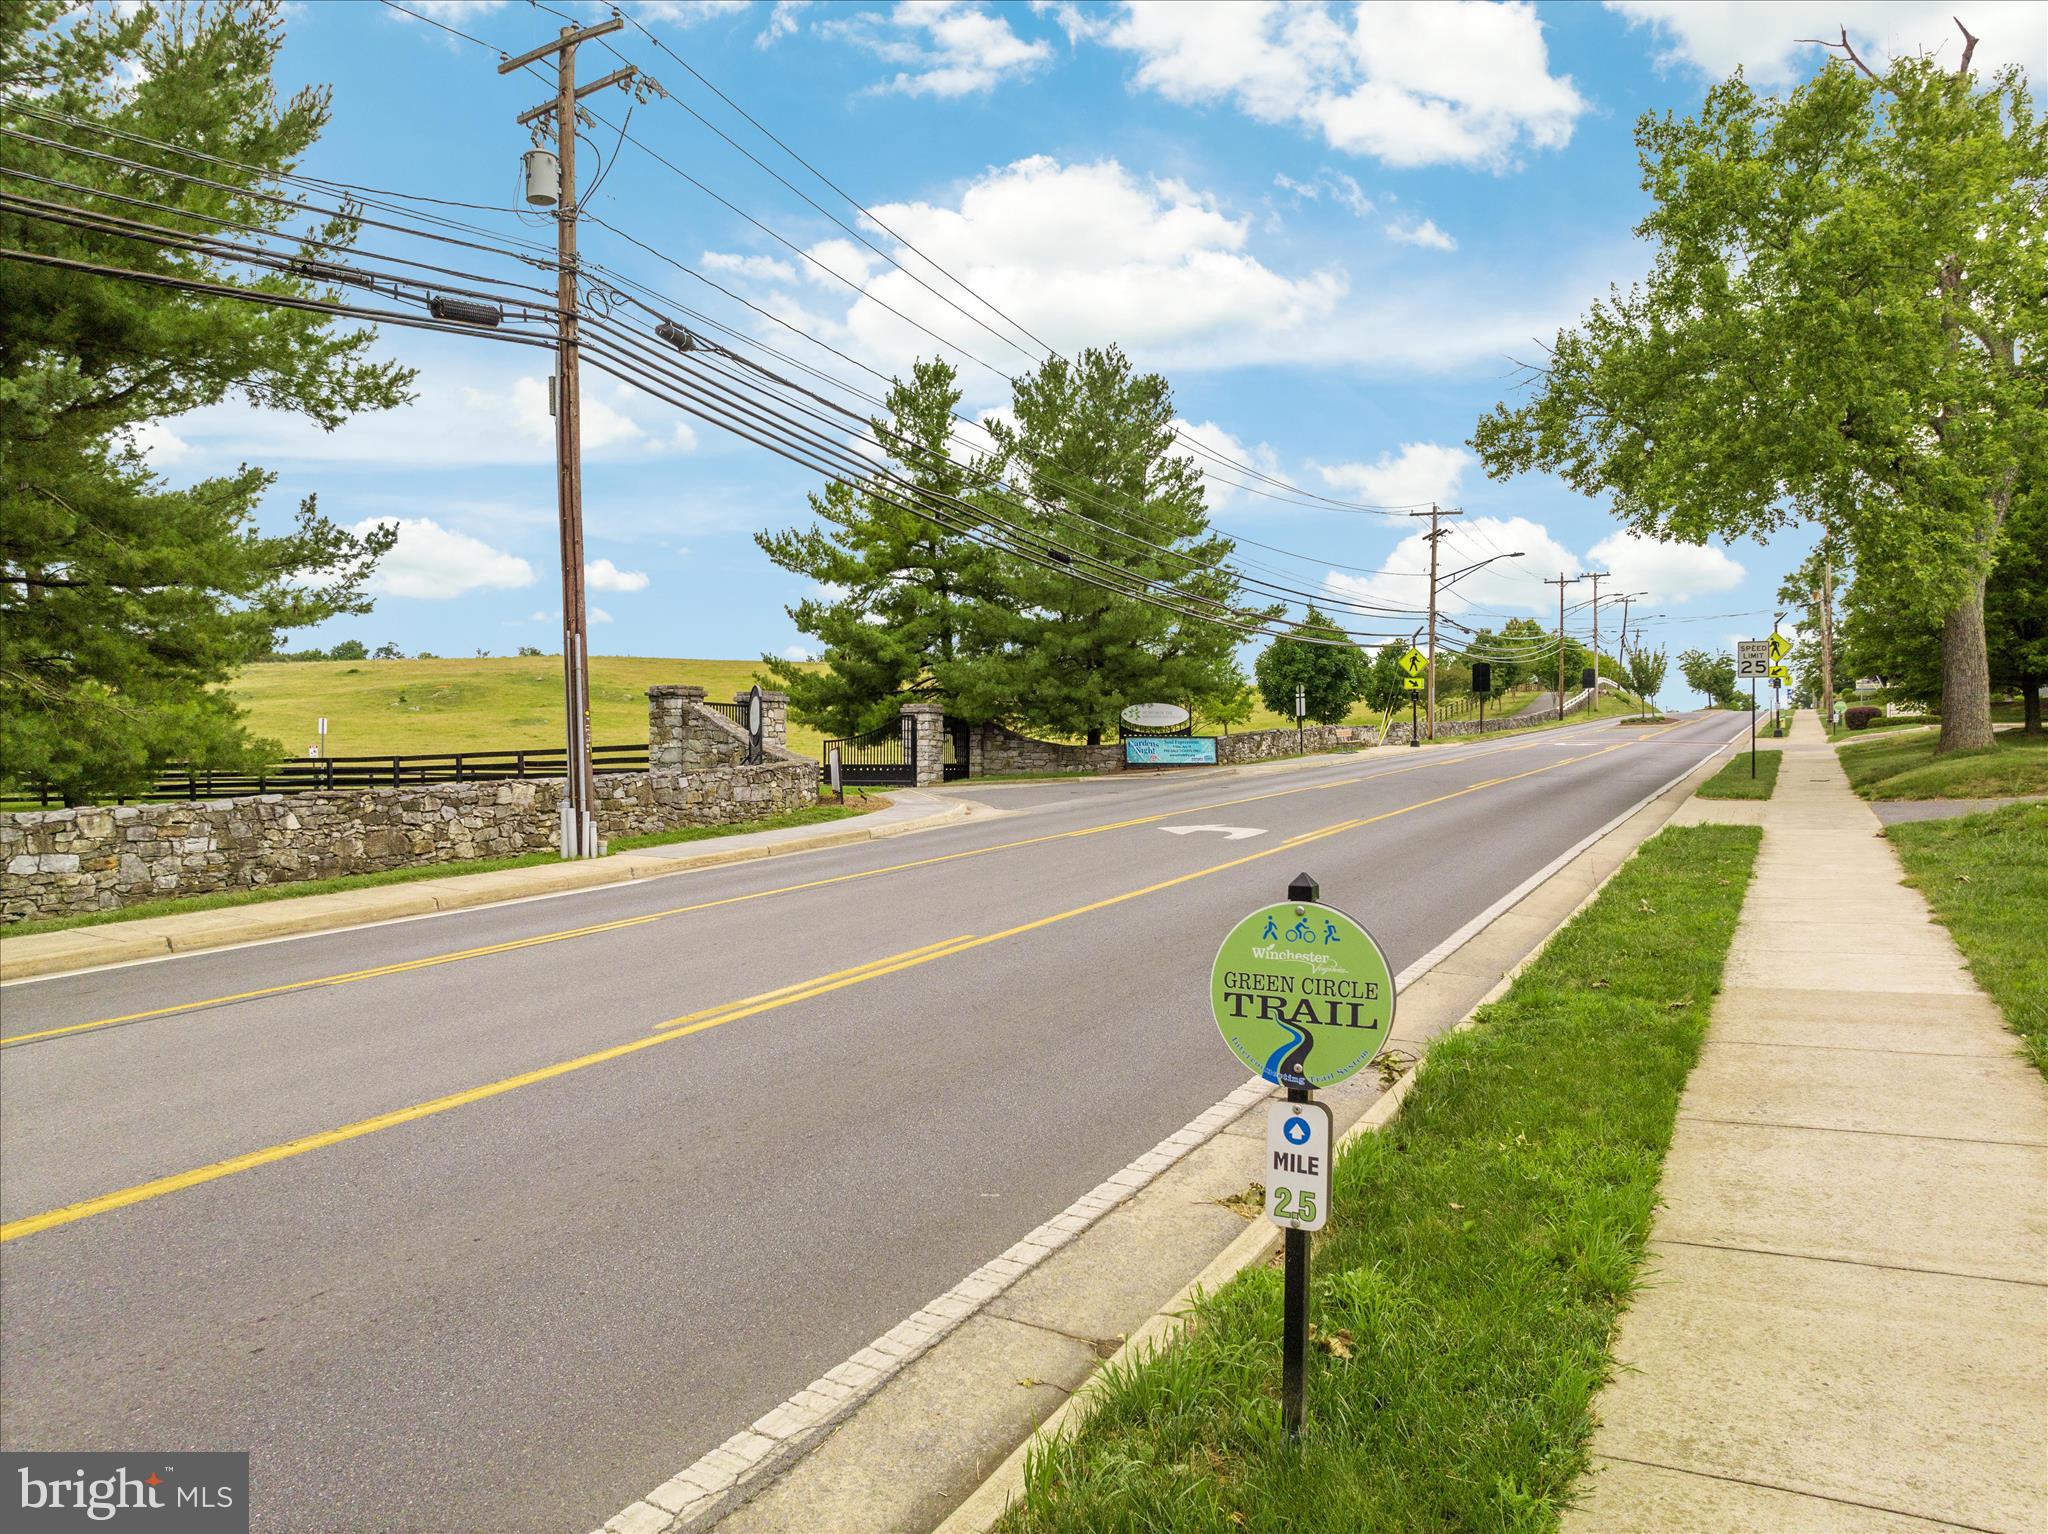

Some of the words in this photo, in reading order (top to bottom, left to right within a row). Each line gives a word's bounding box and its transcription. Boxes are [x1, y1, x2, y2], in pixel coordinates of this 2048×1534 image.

[1740, 660, 1767, 674] 25
[1252, 945, 1330, 964] Winchester
[1223, 972, 1295, 993] GREEN
[1301, 977, 1379, 1001] CIRCLE
[1223, 992, 1379, 1030] TRAIL
[1309, 1073, 1335, 1083] Trail
[1336, 1050, 1370, 1077] System
[1273, 1151, 1320, 1176] MILE
[1273, 1186, 1317, 1222] 2.5
